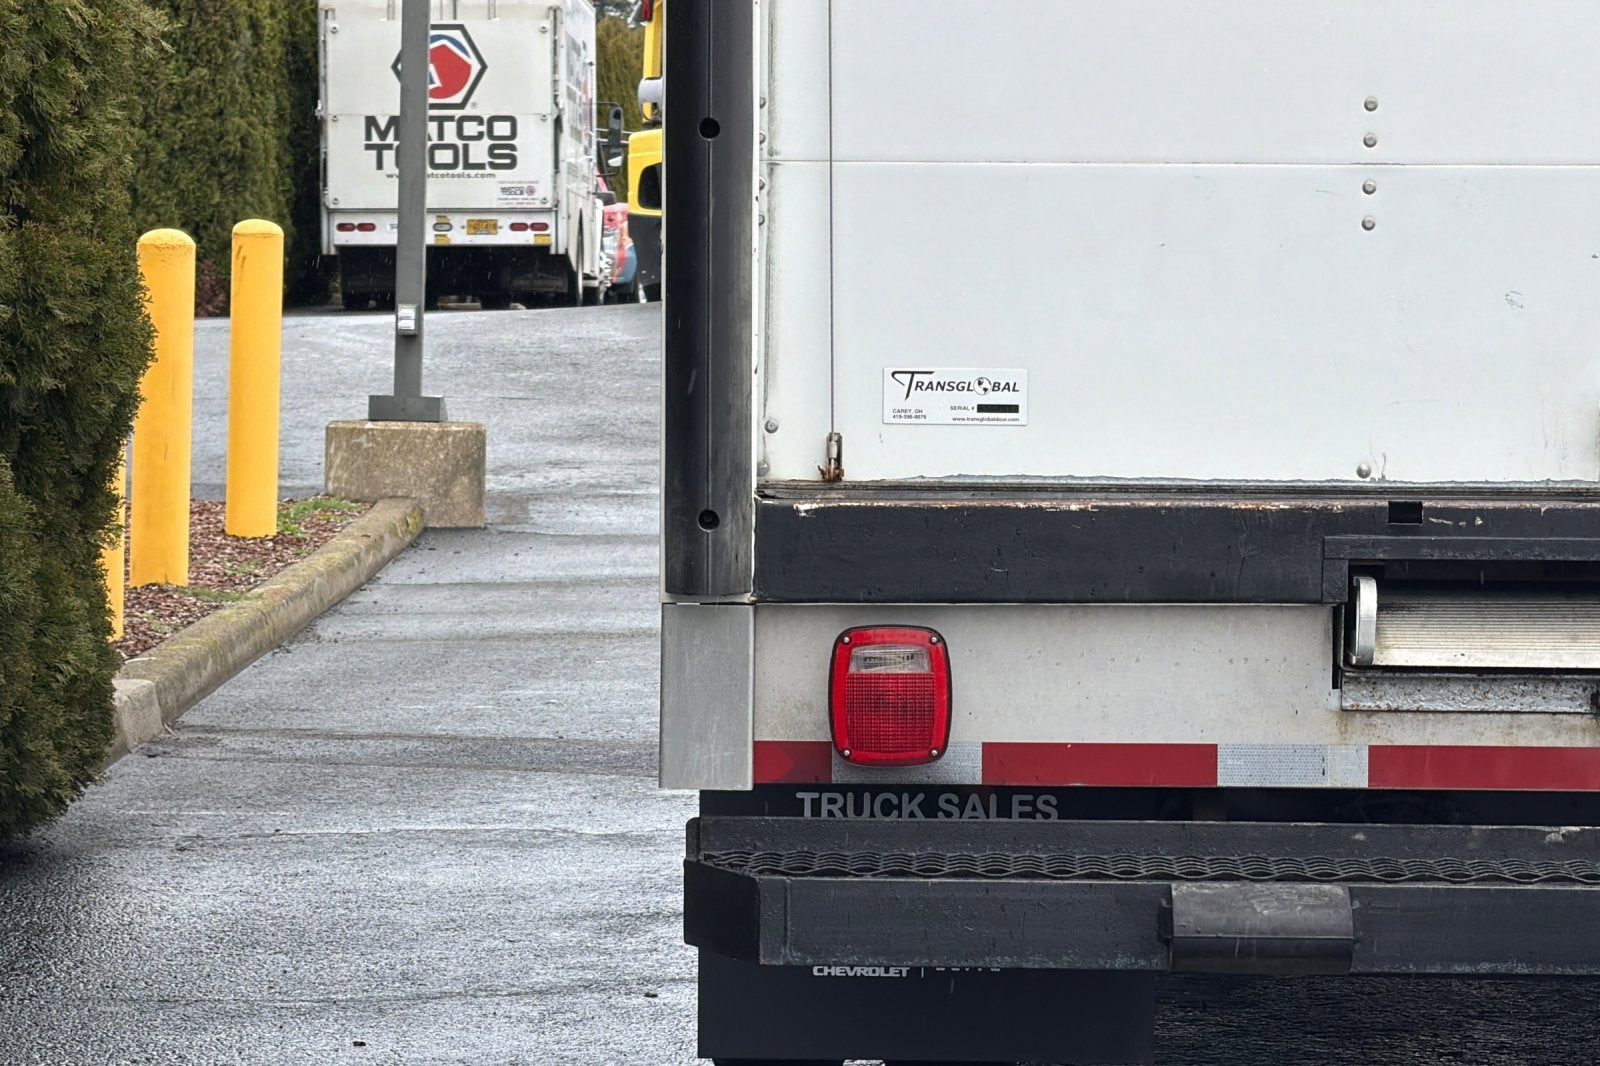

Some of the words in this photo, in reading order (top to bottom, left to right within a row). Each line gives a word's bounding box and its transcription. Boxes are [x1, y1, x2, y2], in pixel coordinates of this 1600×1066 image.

[364, 115, 518, 142] MTCO
[364, 143, 518, 171] TOLS
[891, 370, 1020, 401] TRANSGLOBAL
[796, 791, 926, 819] TRUCK
[937, 793, 1060, 821] SALES
[812, 965, 910, 977] CHEVROLET
